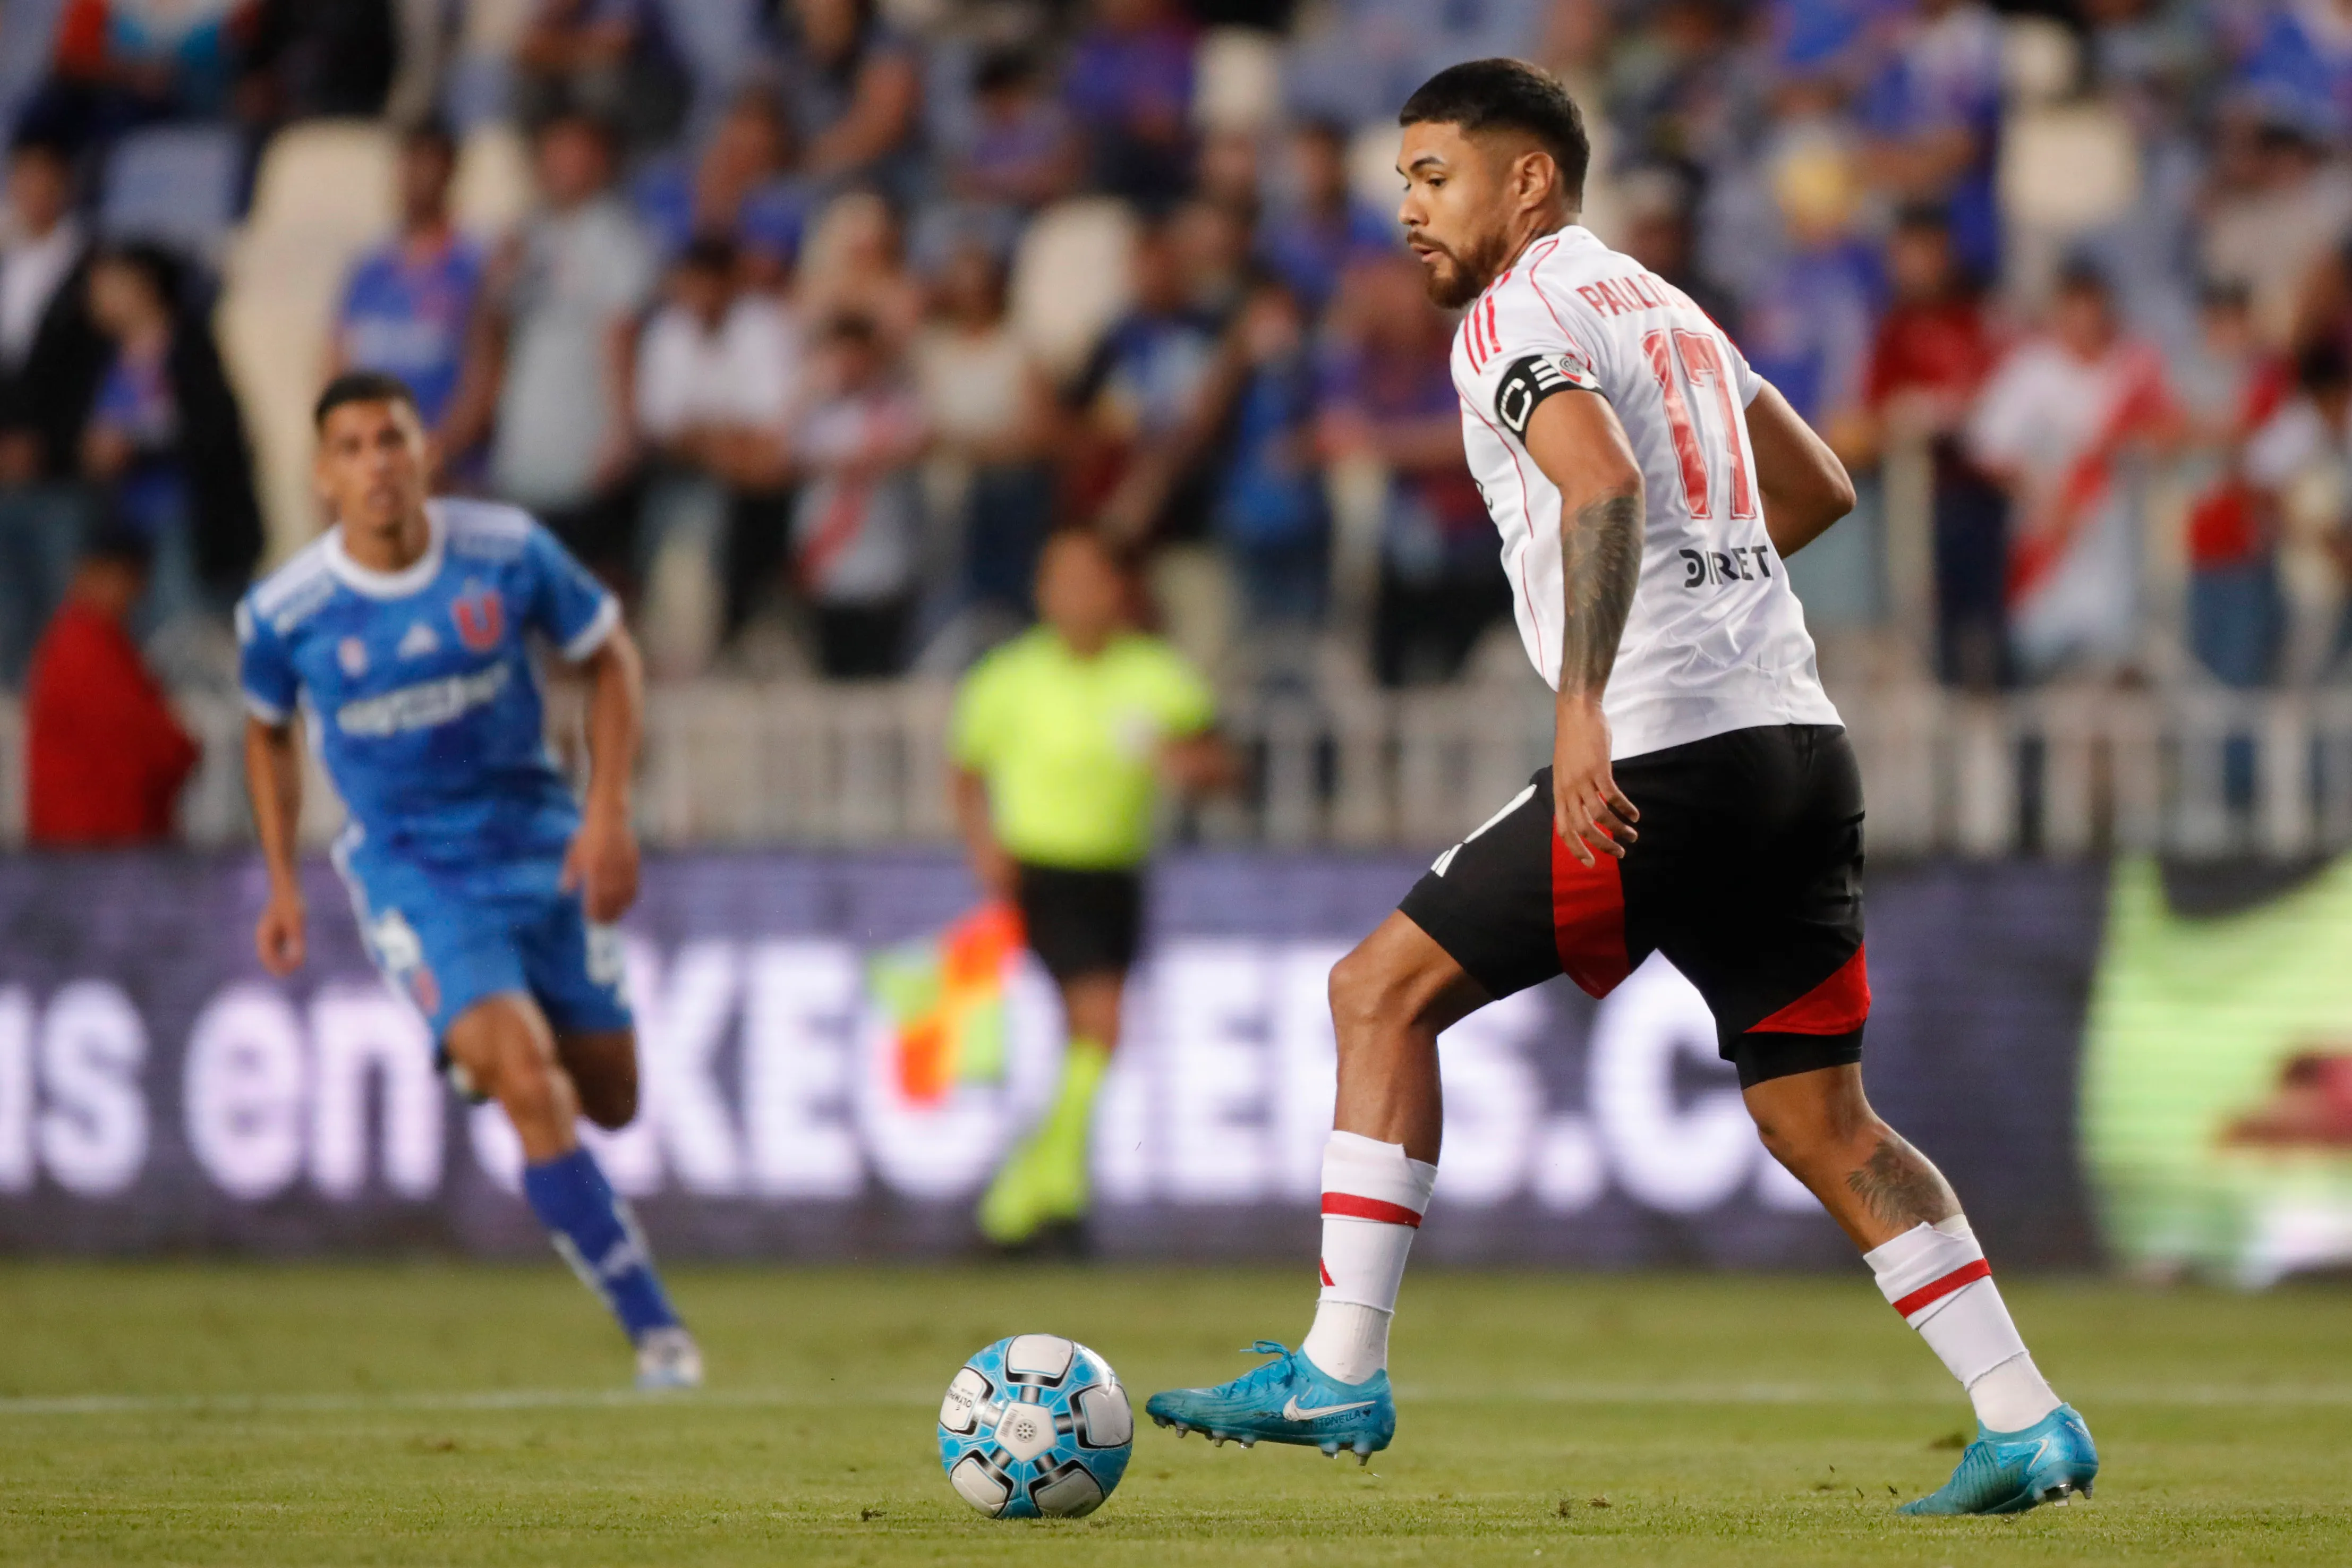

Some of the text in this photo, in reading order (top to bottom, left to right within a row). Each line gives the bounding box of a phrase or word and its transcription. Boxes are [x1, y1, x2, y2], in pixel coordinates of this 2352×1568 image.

[1501, 378, 1533, 432] C
[1640, 328, 1758, 520] 17
[182, 979, 442, 1200] en
